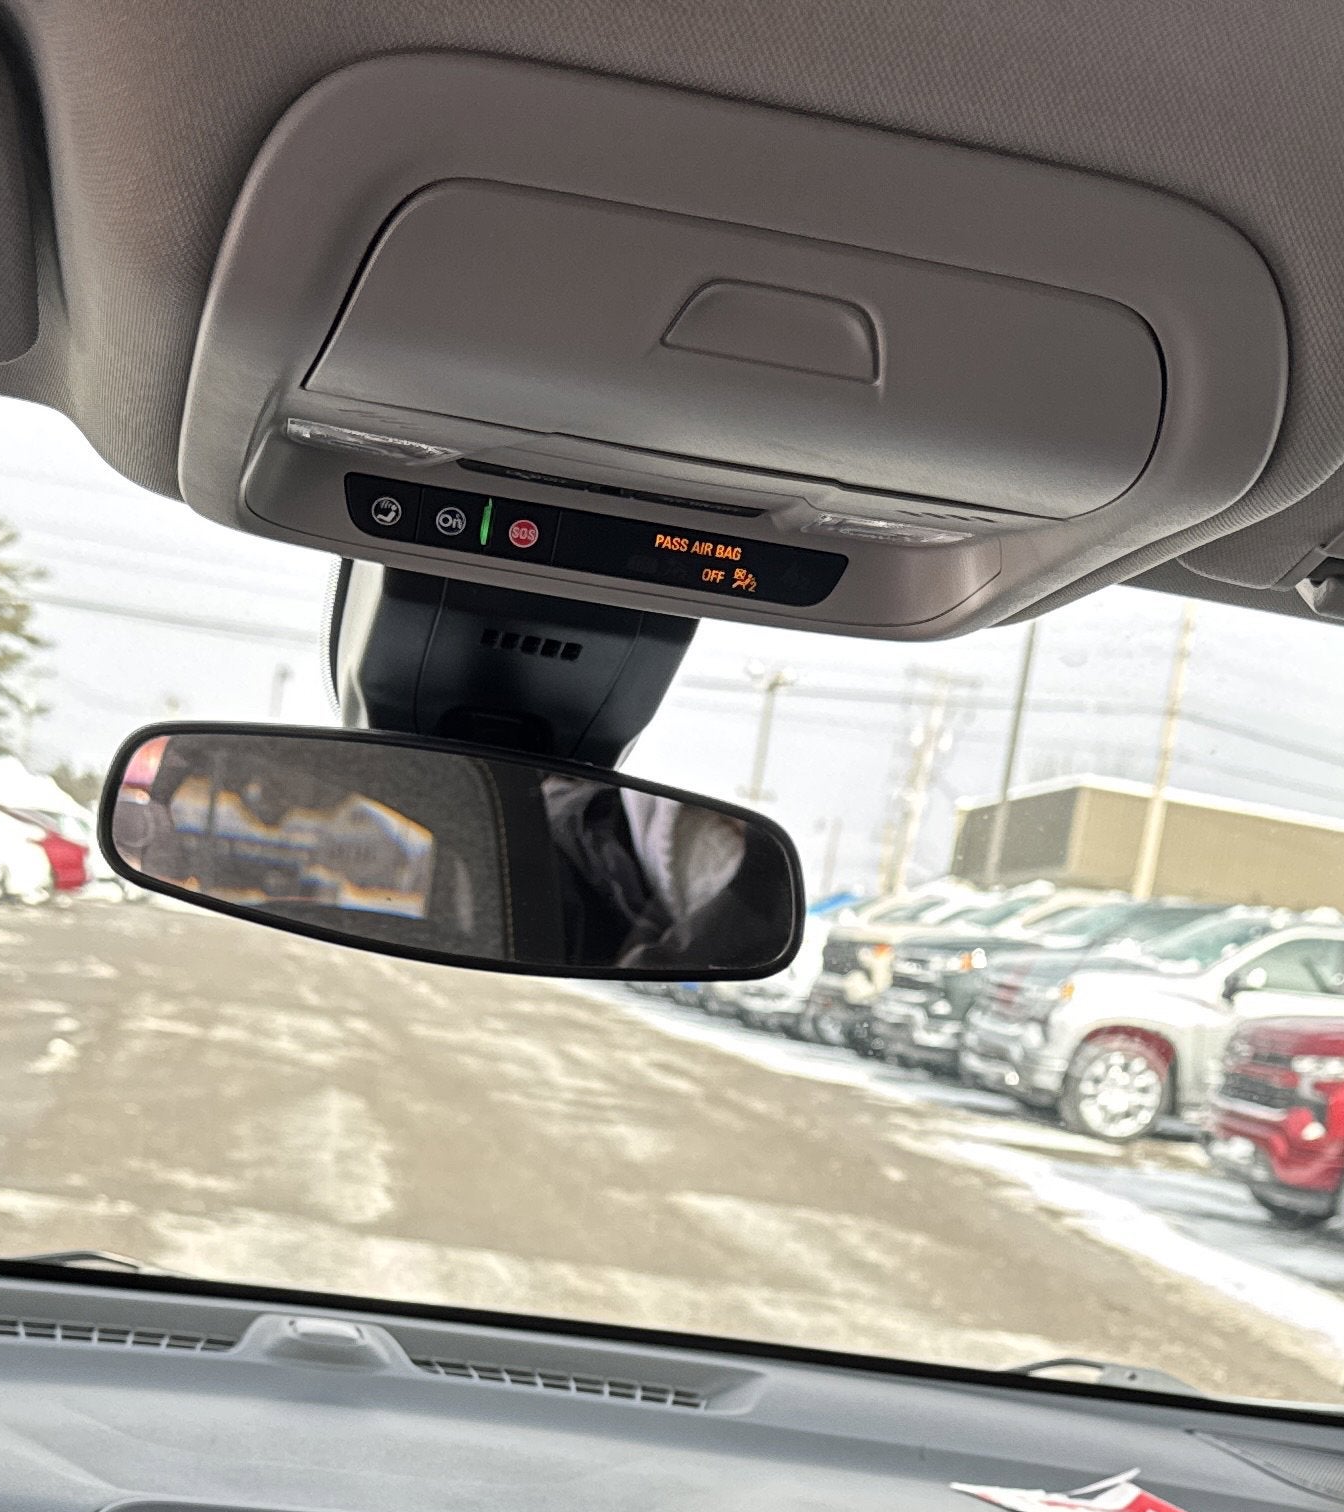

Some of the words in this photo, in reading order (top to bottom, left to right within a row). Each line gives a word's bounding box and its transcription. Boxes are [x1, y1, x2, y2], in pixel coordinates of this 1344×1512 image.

[511, 526, 537, 542] SOS
[655, 534, 690, 554] PASS
[691, 539, 713, 557] AIR
[716, 544, 742, 562] BAG
[702, 568, 725, 584] OFF
